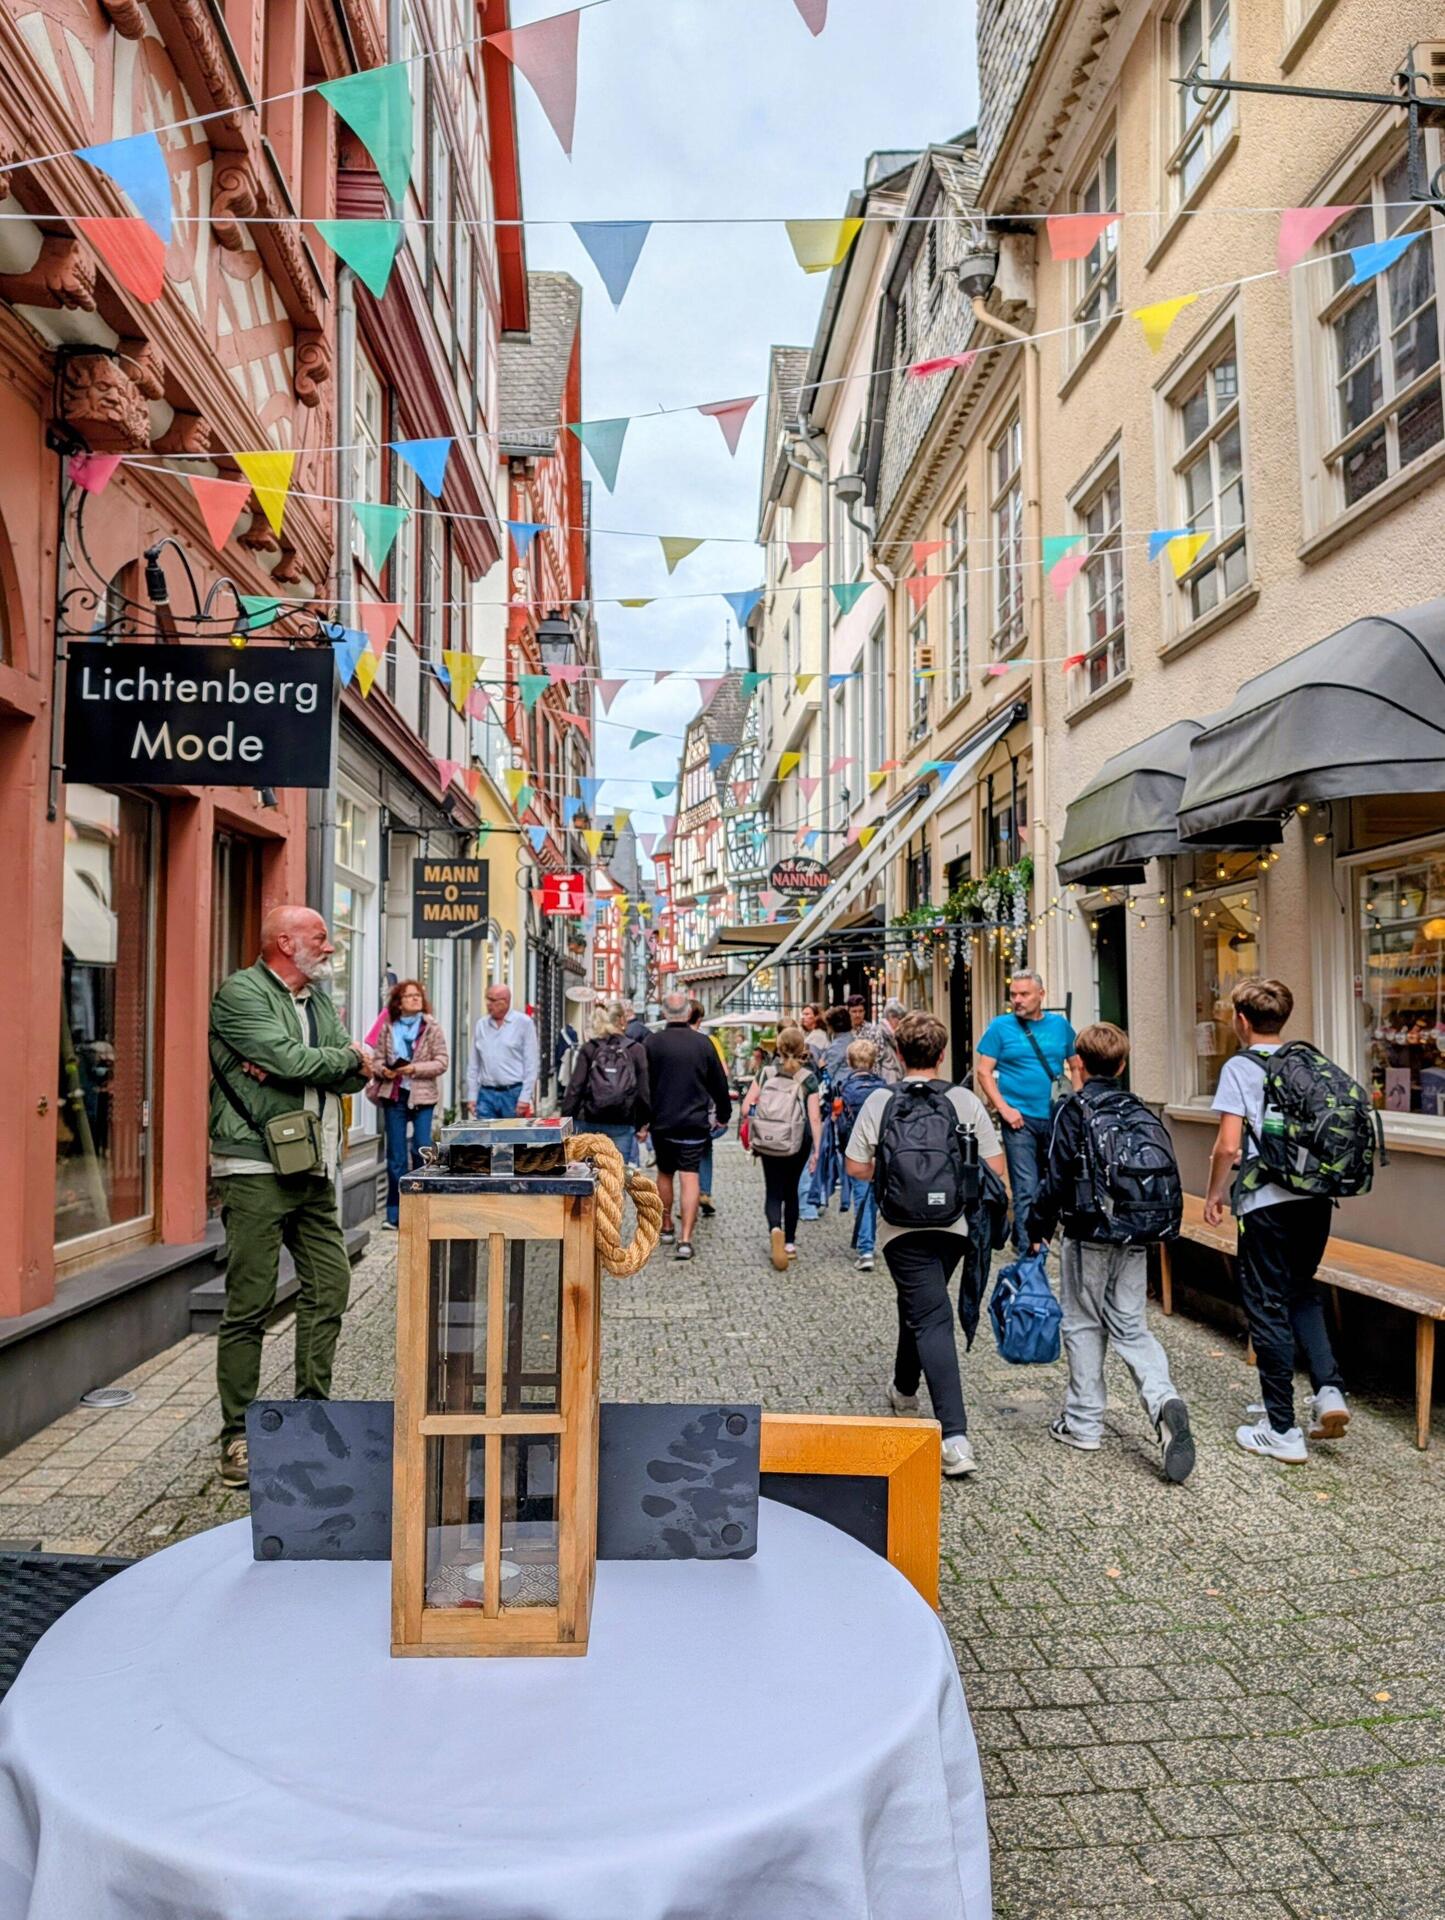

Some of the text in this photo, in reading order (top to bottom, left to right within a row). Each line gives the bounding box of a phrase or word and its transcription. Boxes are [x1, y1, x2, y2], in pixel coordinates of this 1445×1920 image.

[82, 666, 318, 713] Lichtenberg
[130, 721, 263, 761] Mode
[424, 865, 479, 883] MANN
[772, 872, 829, 887] NANNINI
[444, 884, 459, 902] O
[423, 903, 479, 921] MANN
